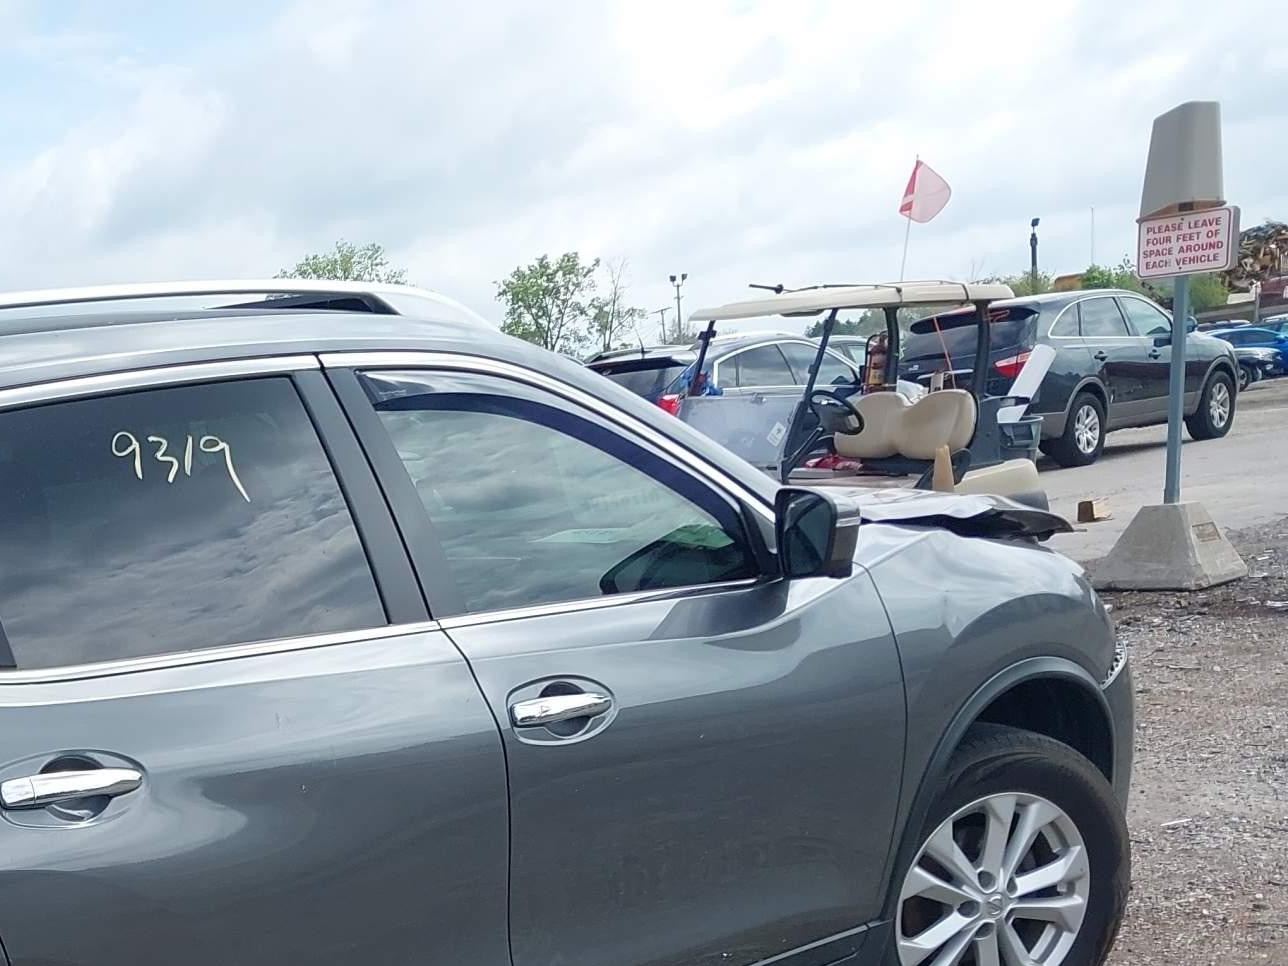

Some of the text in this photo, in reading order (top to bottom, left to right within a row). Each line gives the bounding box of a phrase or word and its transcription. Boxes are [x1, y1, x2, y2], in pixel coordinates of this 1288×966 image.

[1147, 217, 1222, 235] PLEASE LEAVE
[1146, 229, 1221, 247] FOUR FEET OF
[1143, 240, 1224, 259] SPACE AROUND
[1145, 253, 1220, 270] EACH VEHICLE
[111, 431, 251, 503] 9319
